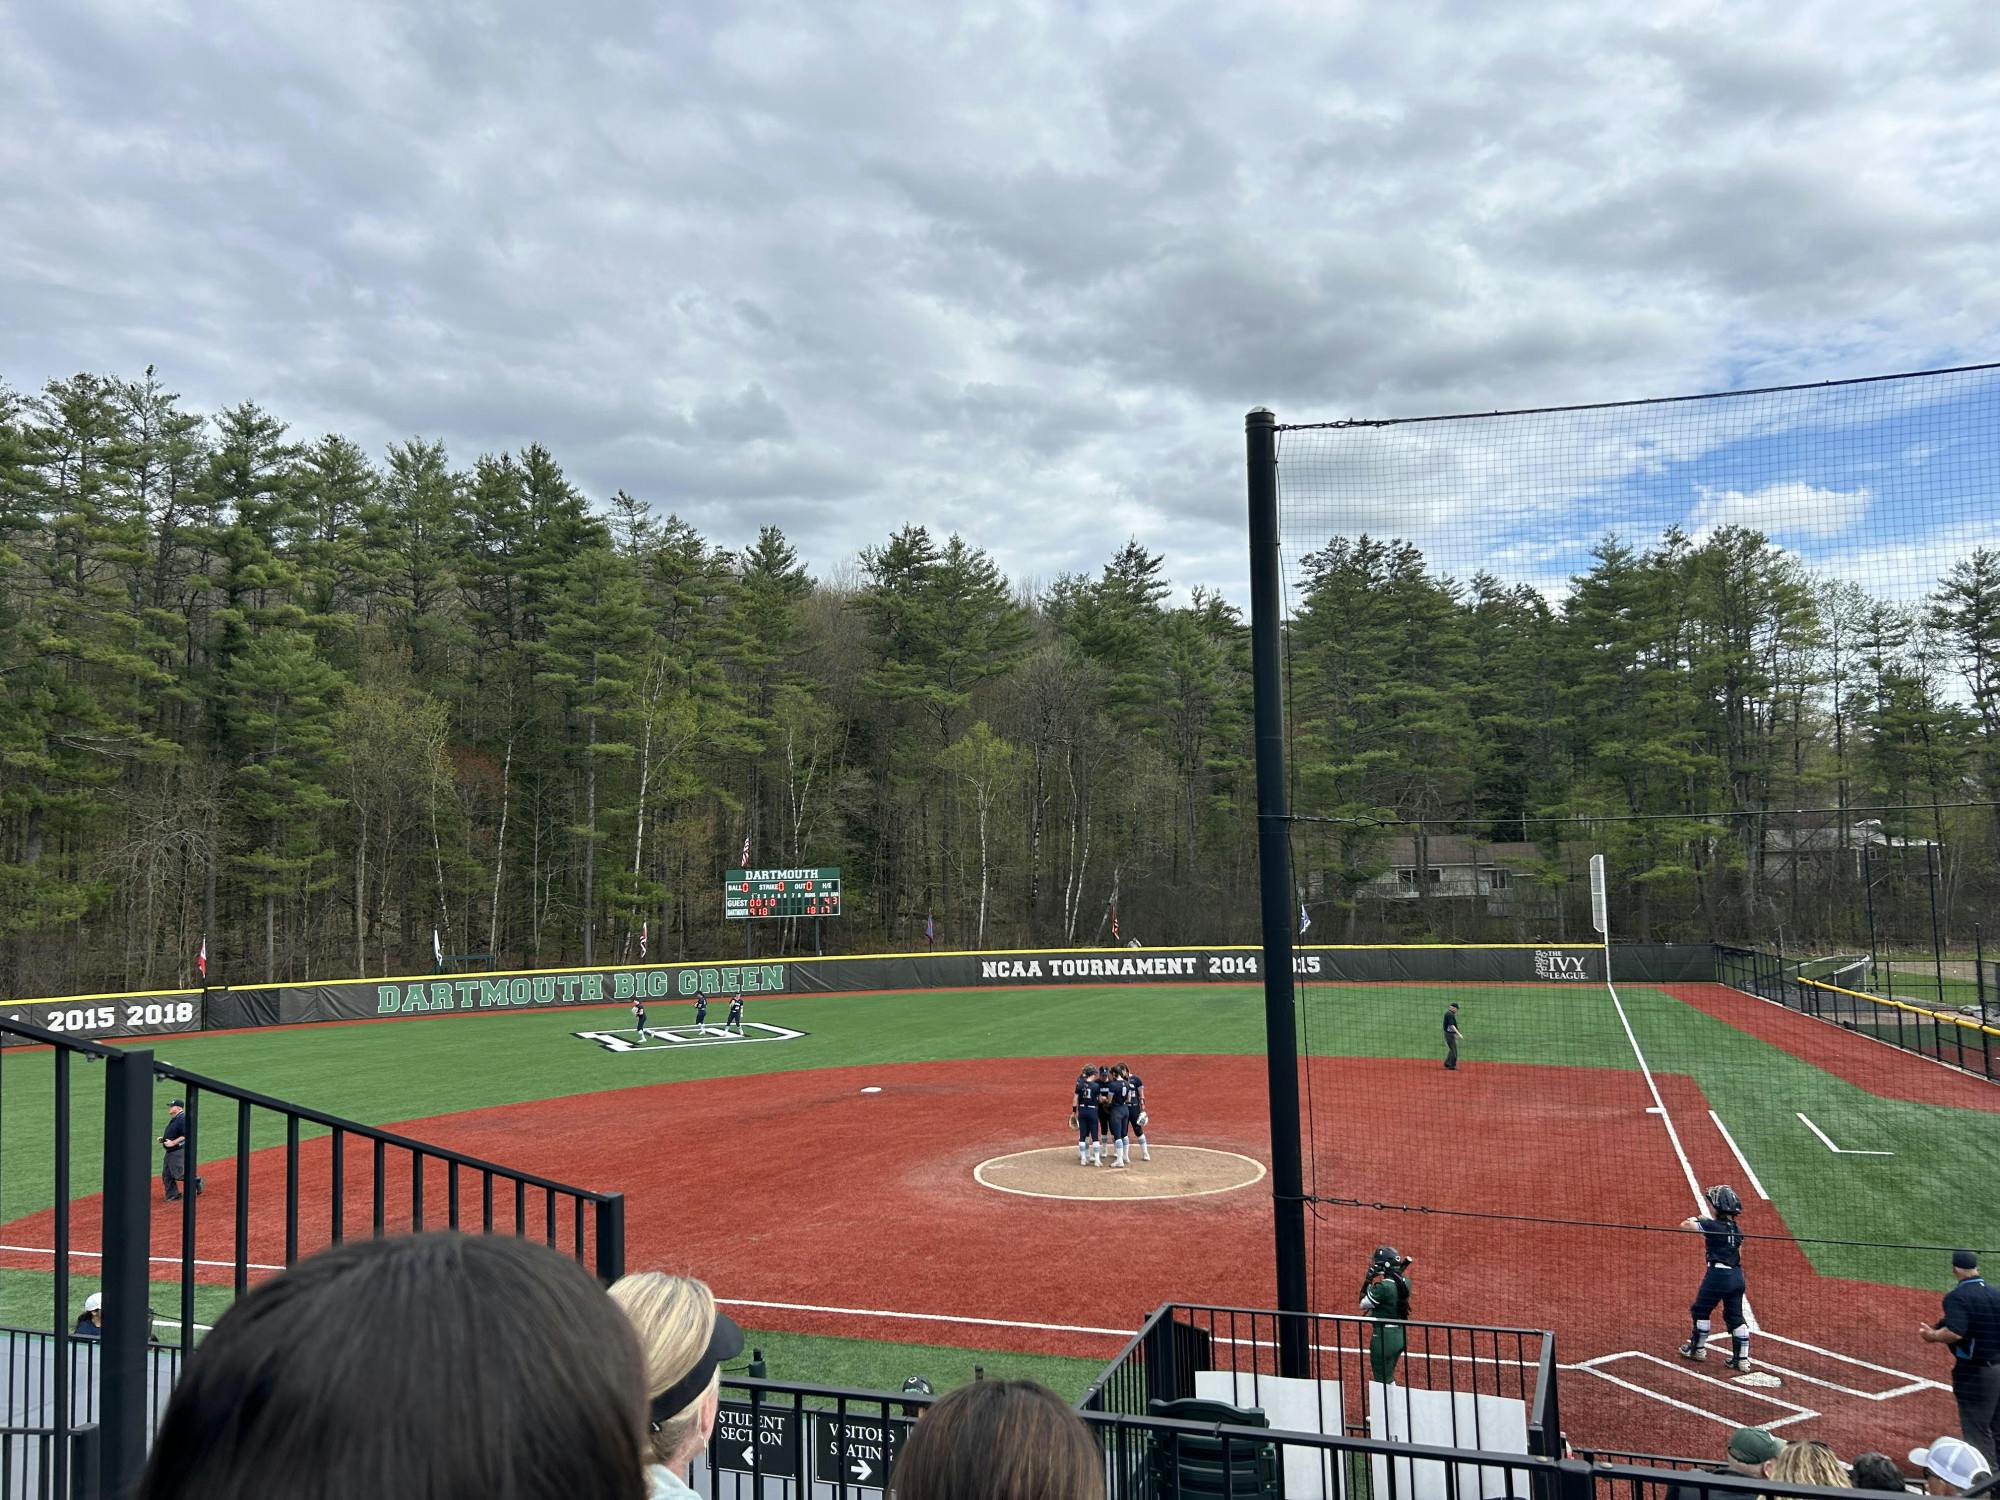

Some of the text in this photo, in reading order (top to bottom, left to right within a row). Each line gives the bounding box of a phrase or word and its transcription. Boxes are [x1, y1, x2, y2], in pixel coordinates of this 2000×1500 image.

[745, 870, 818, 880] DARTMOUTH
[742, 883, 749, 892] 0
[778, 882, 784, 891] 0
[806, 881, 813, 891] 0
[982, 960, 1043, 978] NCAA
[1048, 958, 1196, 977] TOURNAMENT
[1209, 956, 1258, 974] 2014
[1548, 957, 1584, 972] IVY
[377, 964, 784, 1014] DARTMOUTH BIG GREEN
[47, 1006, 115, 1032] 2015
[126, 1002, 193, 1026] 2018
[721, 1426, 782, 1446] SECTON
[829, 1423, 895, 1443] VSITOS
[830, 1442, 893, 1462] SATIN
